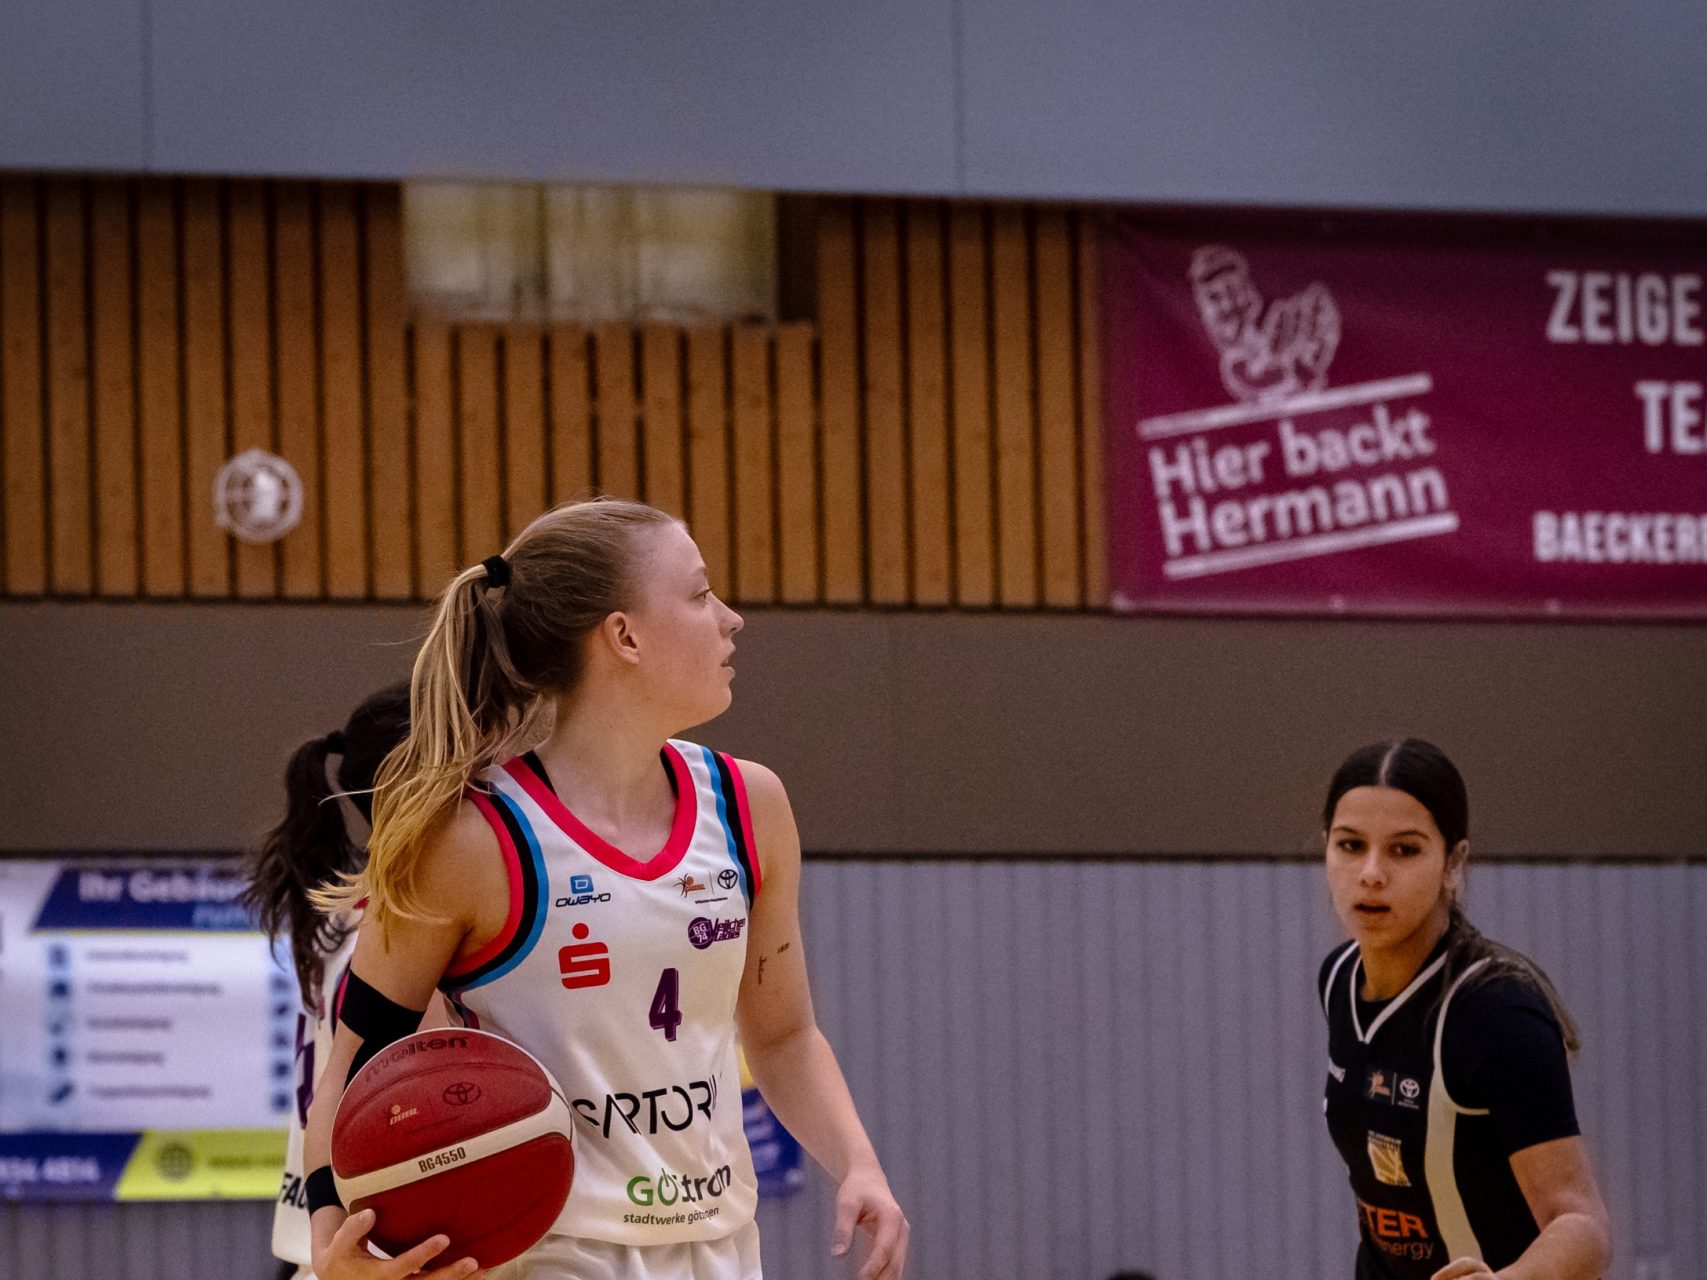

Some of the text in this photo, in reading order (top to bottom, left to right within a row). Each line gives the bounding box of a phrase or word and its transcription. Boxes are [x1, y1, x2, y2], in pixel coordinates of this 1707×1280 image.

[1545, 270, 1705, 345] ZEIGE
[1149, 404, 1434, 500] Hier backt
[1635, 381, 1707, 454] TE
[1159, 466, 1449, 557] Hermann
[649, 967, 682, 1042] 4
[571, 1074, 717, 1139] SARTOR
[418, 1147, 466, 1173] BG4550
[623, 1213, 686, 1225] stadtwerke
[1357, 1197, 1429, 1238] TER
